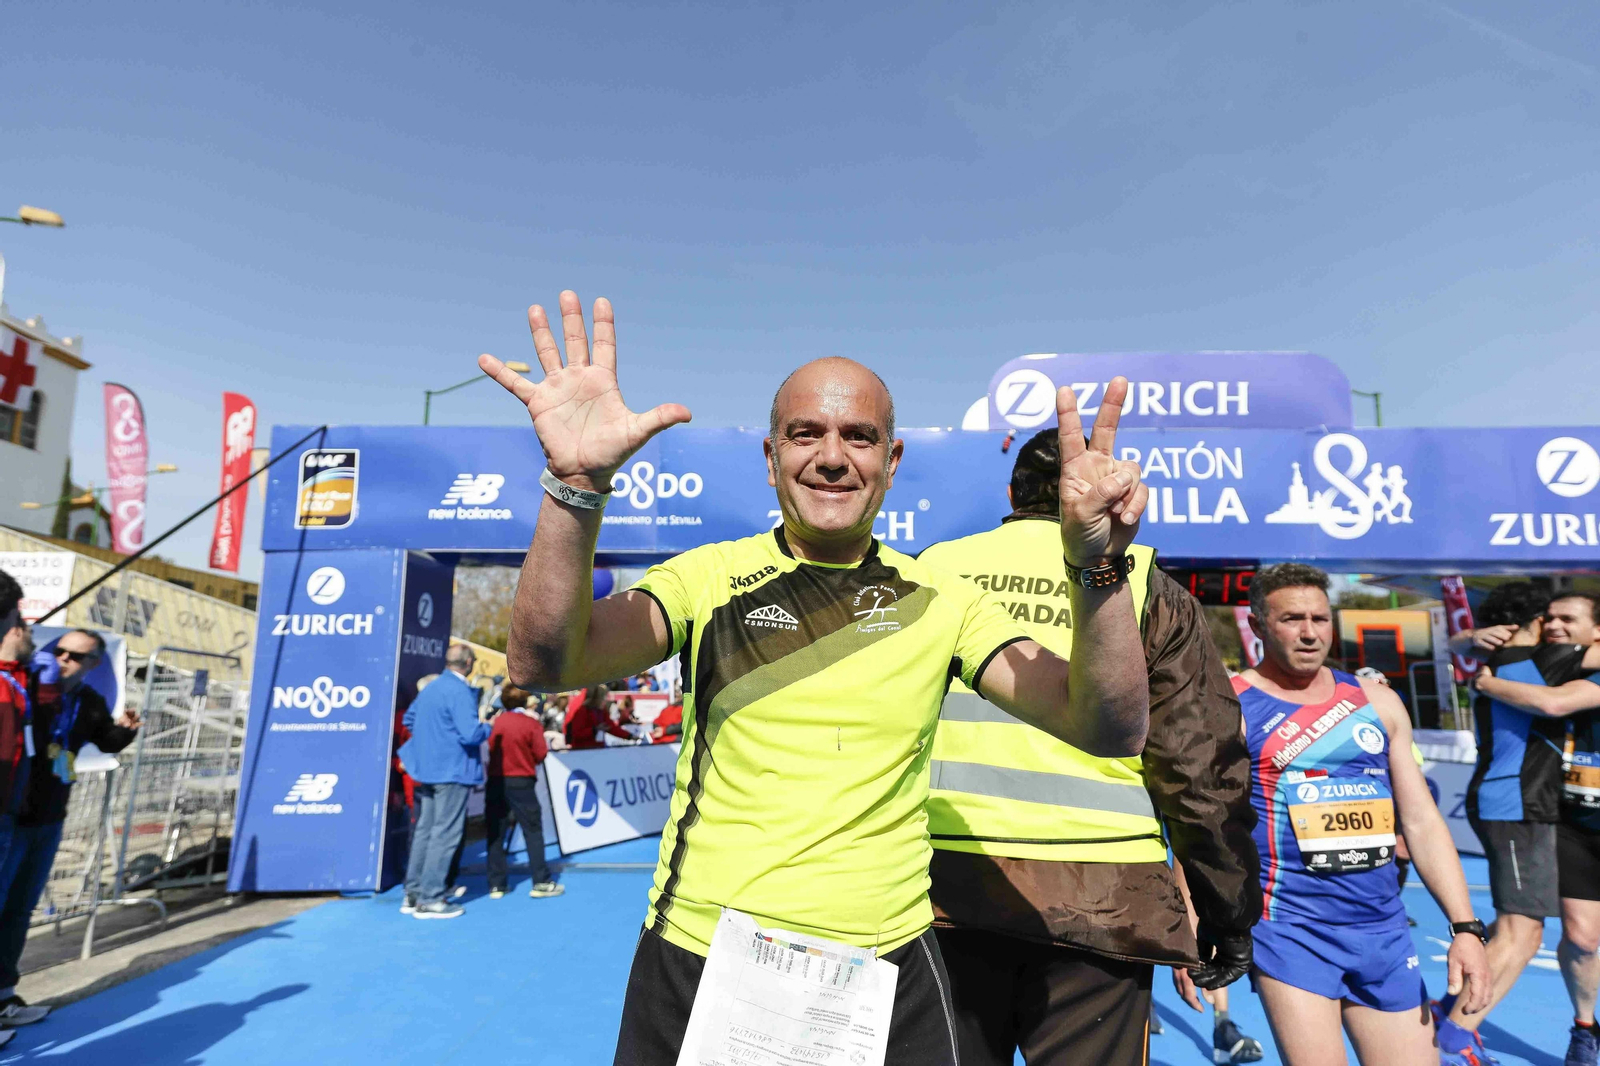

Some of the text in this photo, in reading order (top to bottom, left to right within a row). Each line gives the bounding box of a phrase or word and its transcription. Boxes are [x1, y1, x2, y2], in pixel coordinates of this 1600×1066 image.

[428, 506, 512, 520] new balance
[1489, 513, 1600, 546] ZURI
[959, 574, 1071, 599] GURIDA
[271, 613, 374, 636] ZURICH
[744, 619, 798, 631] ESMONSUR
[403, 634, 444, 658] ZURICH
[1271, 699, 1357, 770] Atletismo LEBRIJA
[1277, 720, 1301, 740] Club
[606, 772, 677, 808] ZURICH
[1322, 783, 1378, 797] ZURICH
[272, 802, 343, 815] new balance
[1321, 811, 1374, 832] 2960
